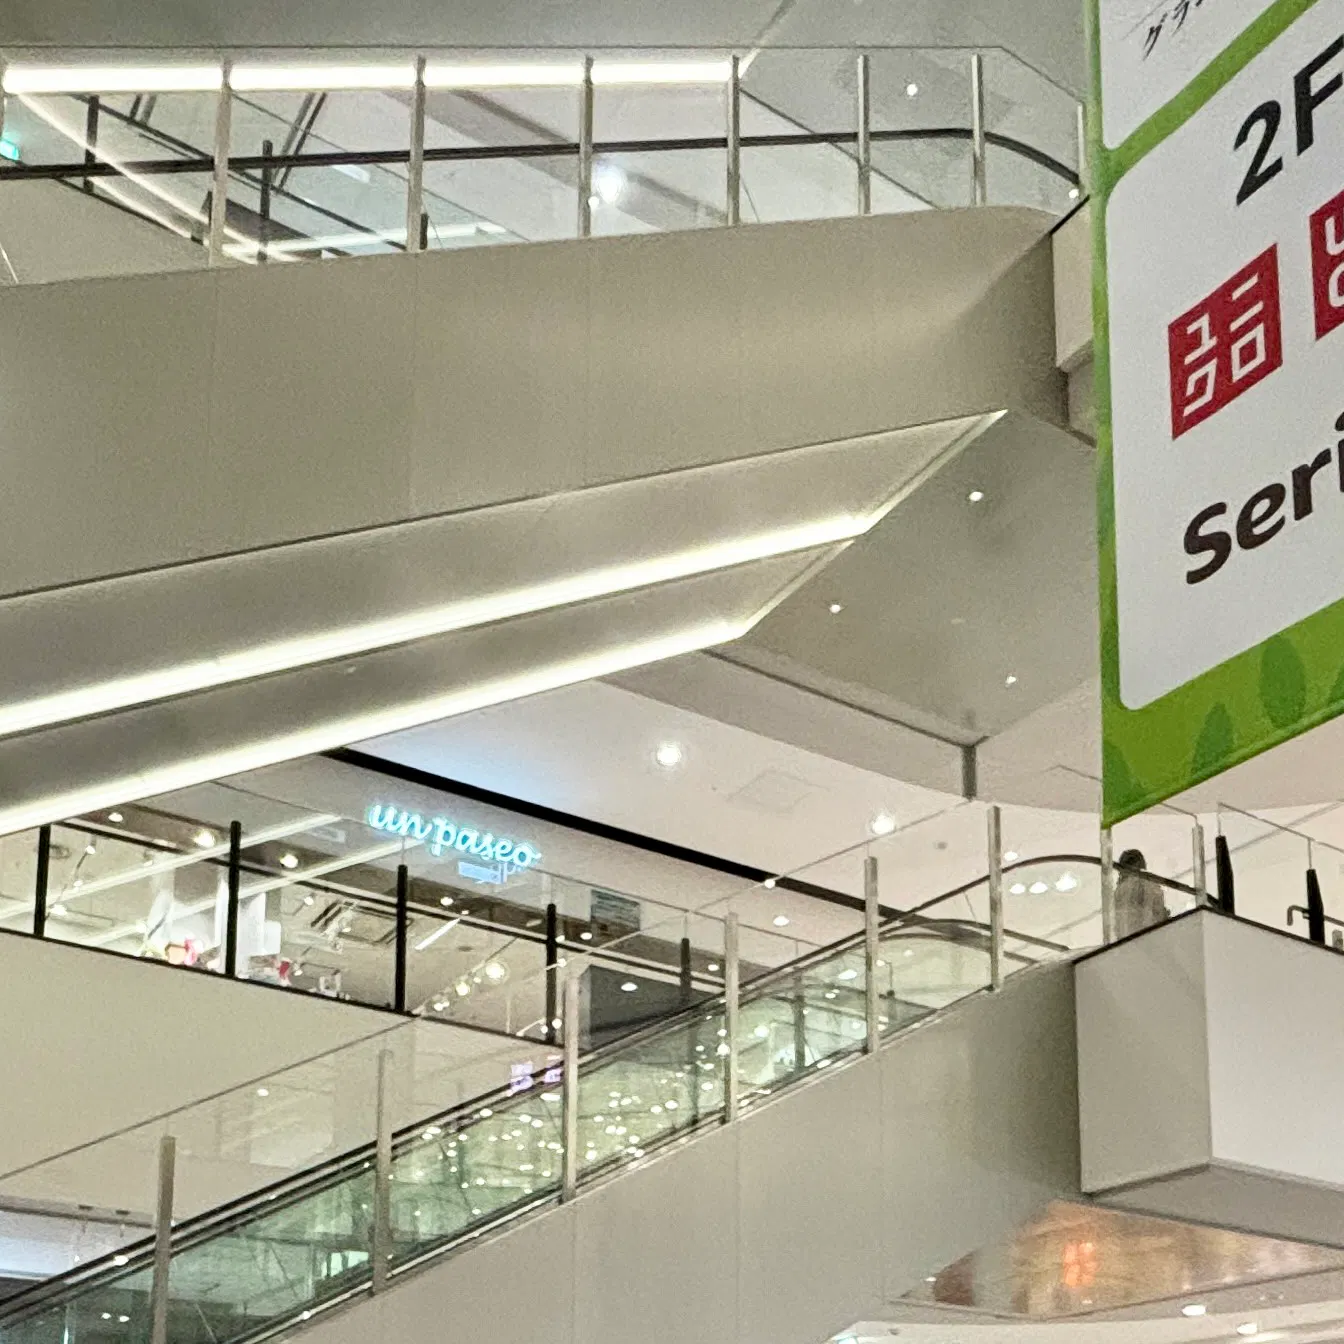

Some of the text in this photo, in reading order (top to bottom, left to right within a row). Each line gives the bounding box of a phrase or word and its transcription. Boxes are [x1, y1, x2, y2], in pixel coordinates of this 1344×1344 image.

[1182, 271, 1265, 367] ユニ
[1181, 321, 1267, 419] クロ
[367, 804, 543, 868] un paseo
